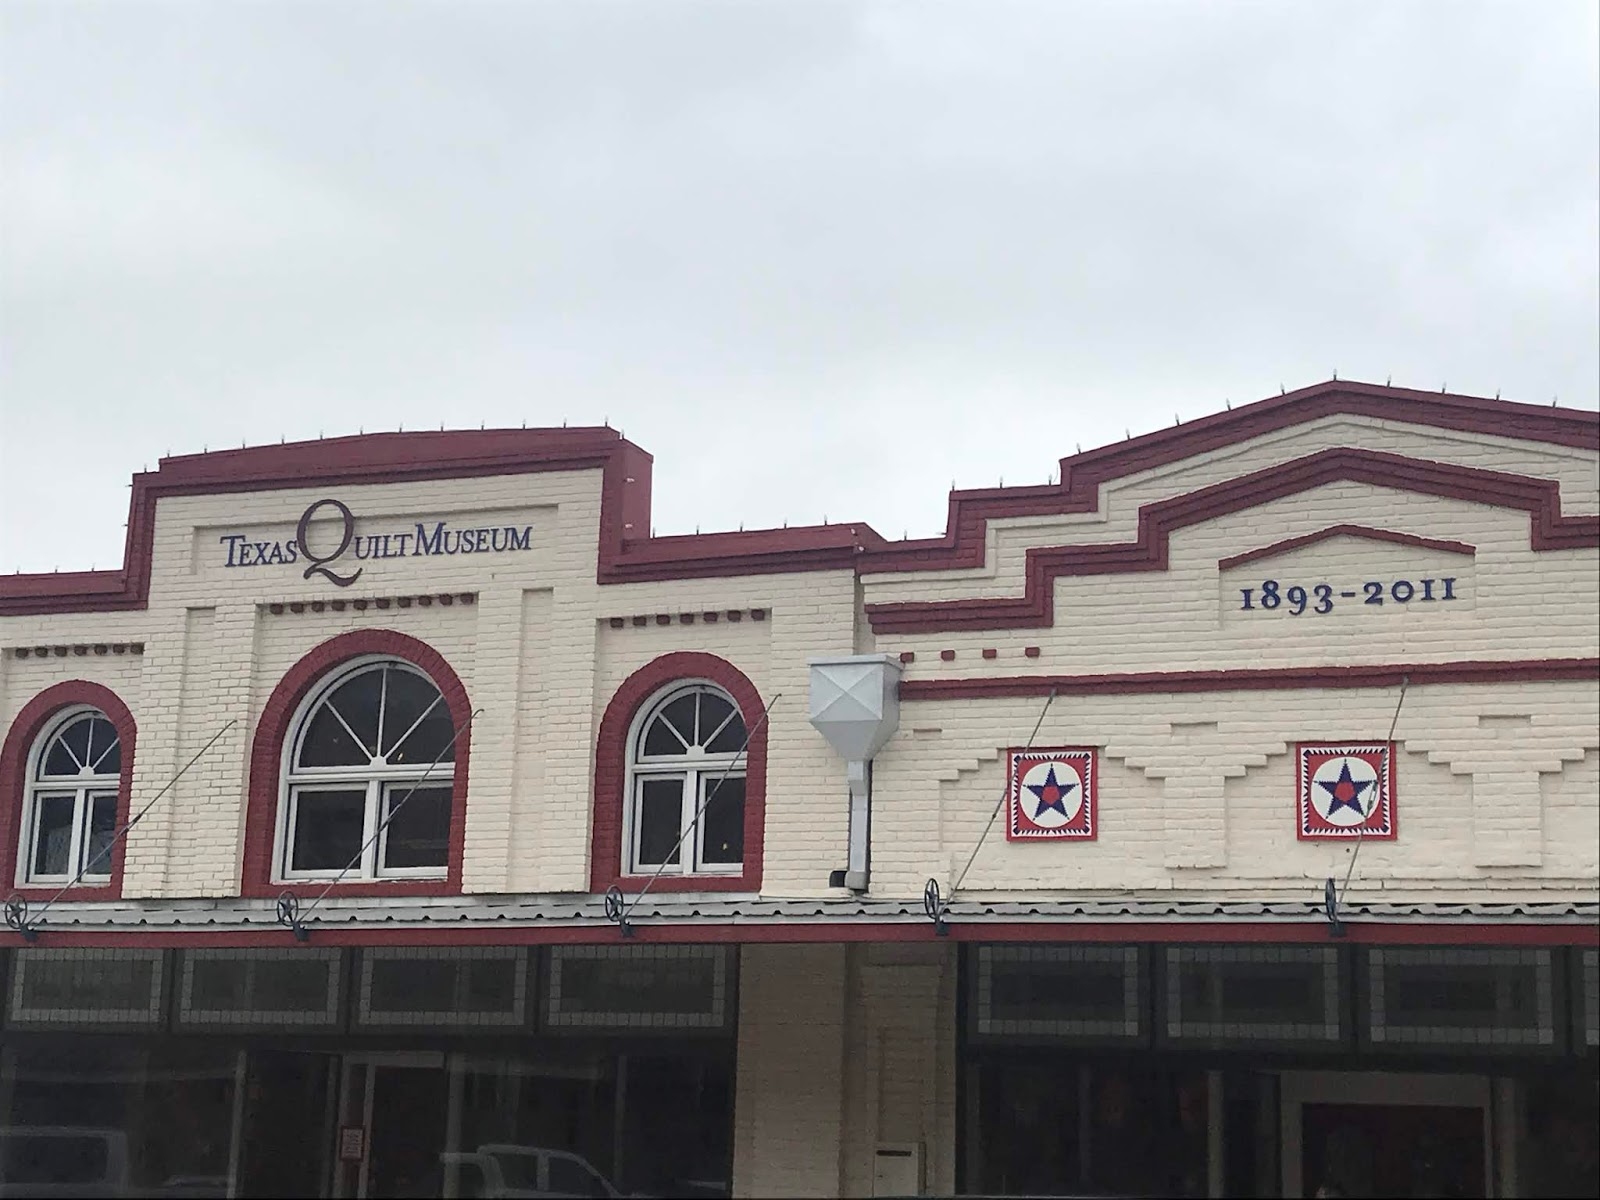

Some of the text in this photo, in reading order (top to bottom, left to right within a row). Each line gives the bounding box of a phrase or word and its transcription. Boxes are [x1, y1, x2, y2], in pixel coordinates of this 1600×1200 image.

[220, 499, 533, 587] TEXAS QUILT MUSEUM
[1240, 578, 1457, 616] 1893-2011
